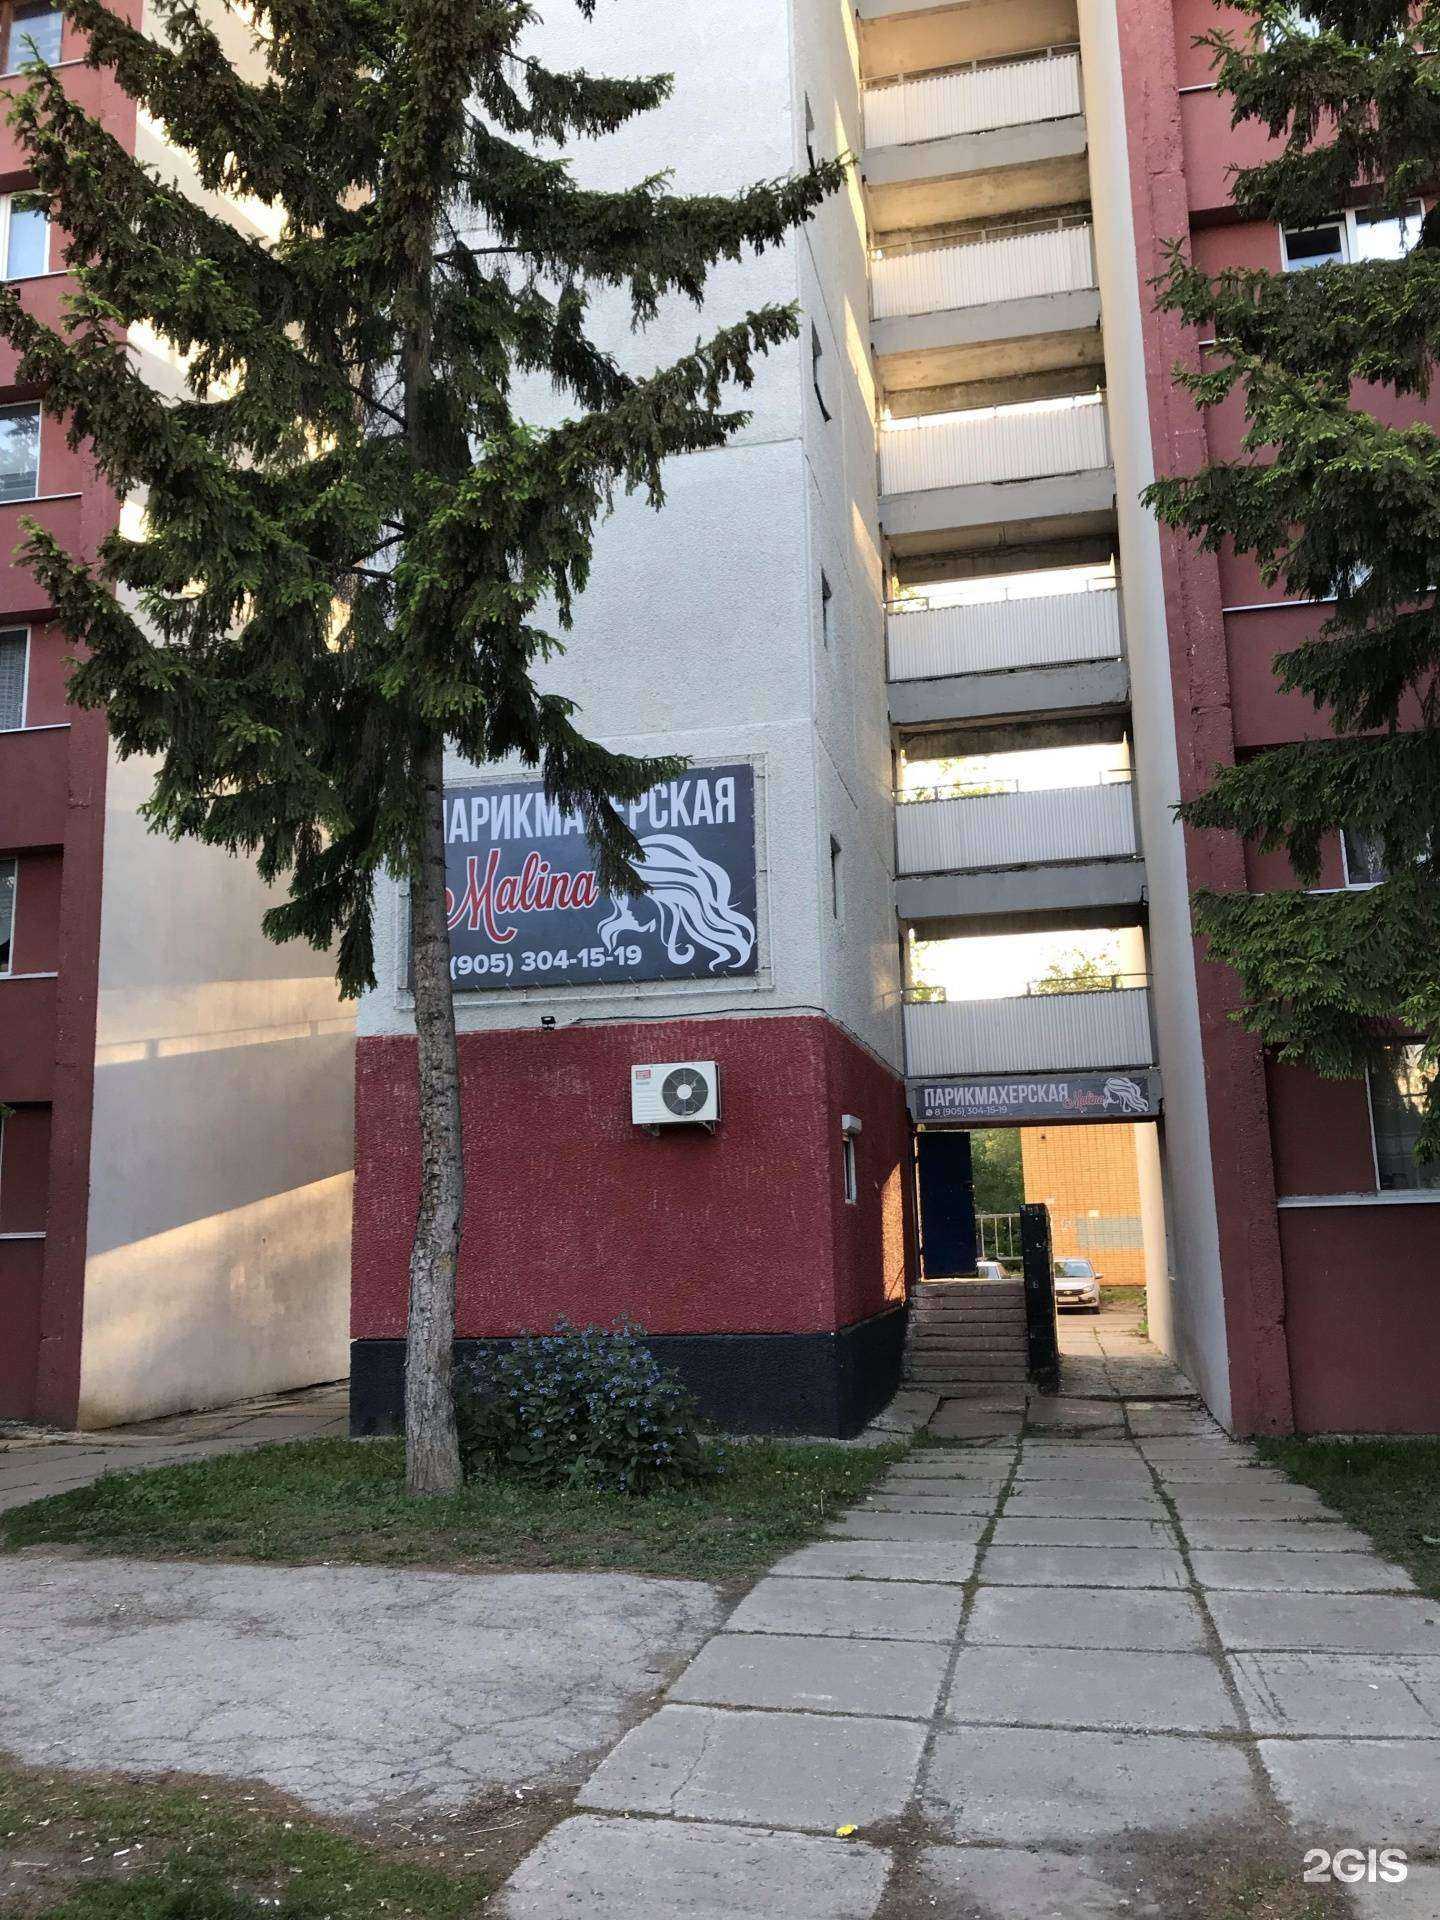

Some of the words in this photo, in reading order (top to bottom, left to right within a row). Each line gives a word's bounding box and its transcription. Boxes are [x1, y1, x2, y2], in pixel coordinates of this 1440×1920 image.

[446, 848, 598, 943] Malina
[450, 953, 513, 980] (905)
[521, 945, 642, 972] 304-15-19
[924, 1083, 1068, 1107] ПАРИКМАХЕРСКАЯ
[943, 1107, 965, 1117] (905)
[967, 1105, 1008, 1115] 304-15-19
